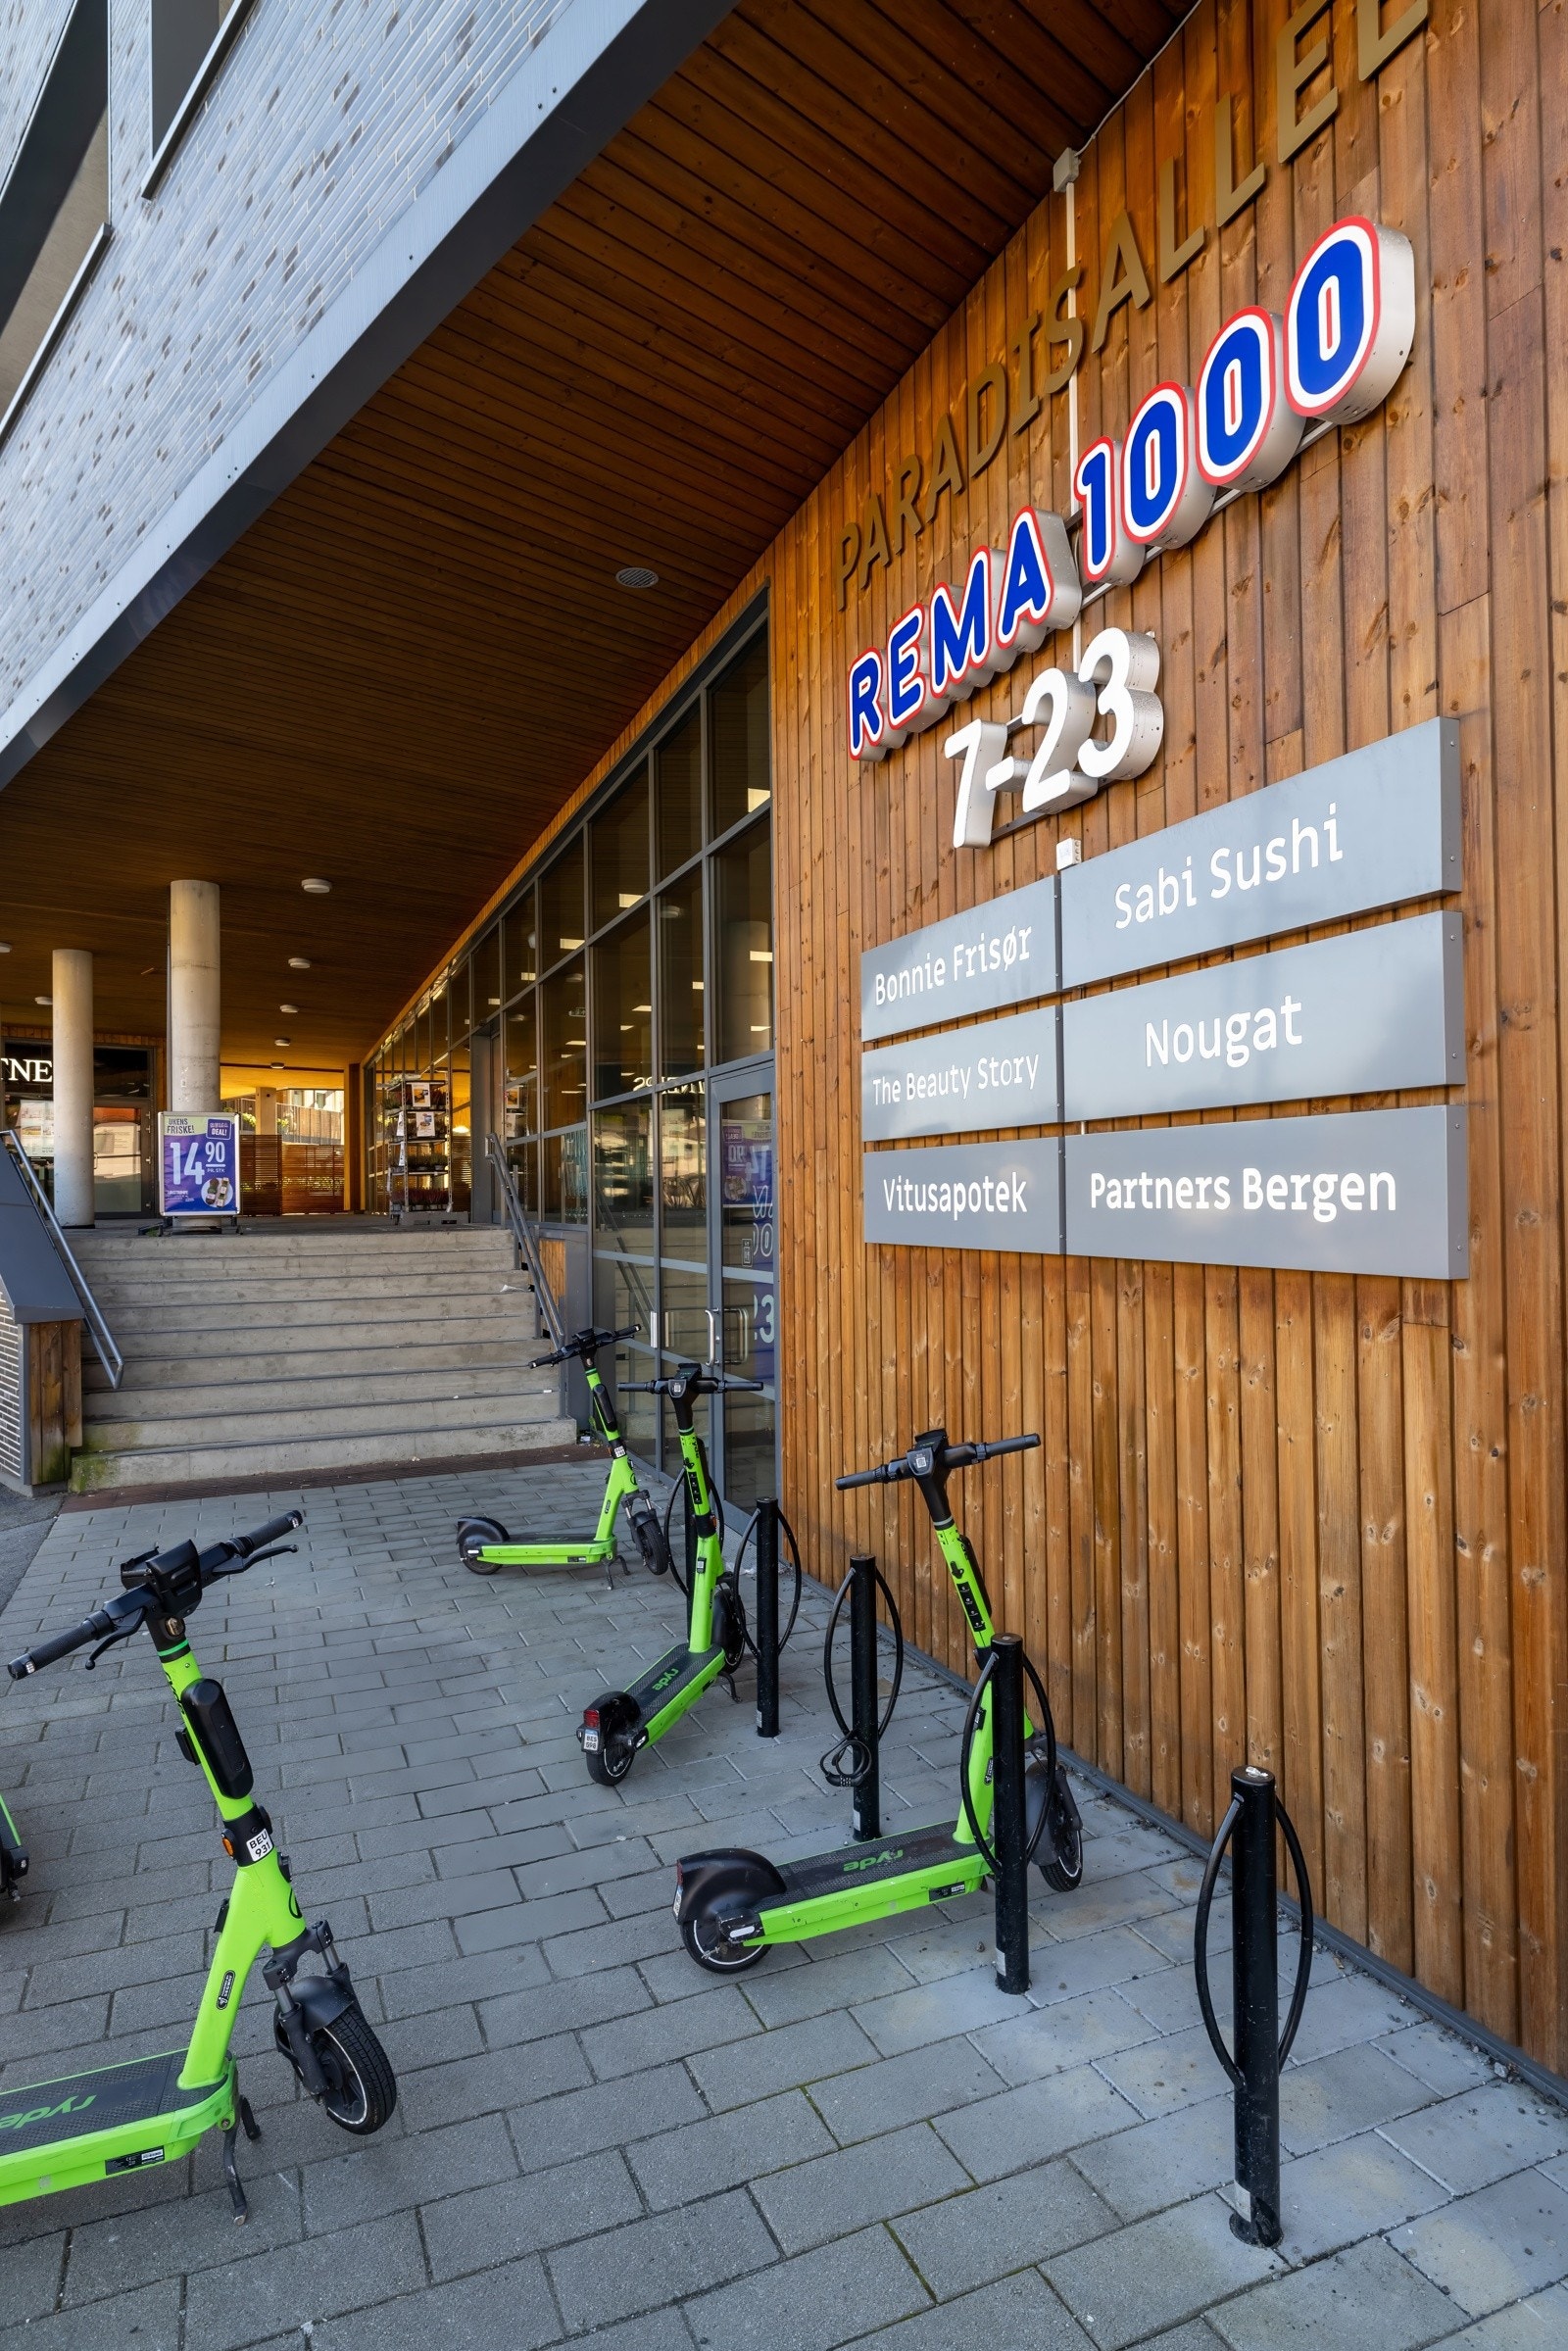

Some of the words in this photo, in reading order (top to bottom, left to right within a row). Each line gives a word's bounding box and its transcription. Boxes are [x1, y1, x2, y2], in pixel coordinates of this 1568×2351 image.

[849, 505, 1055, 761] REMA
[1074, 215, 1381, 582] 1000
[944, 626, 1137, 850] 7-23
[1113, 855, 1198, 930] Sabi
[1209, 801, 1344, 900] Sushi
[874, 952, 947, 1007] Bonnie
[953, 924, 1032, 983] Frisør
[1145, 994, 1303, 1068] Nougat
[872, 1075, 902, 1106] The
[906, 1064, 972, 1100] Beauty
[977, 1053, 1040, 1090] Story
[167, 1125, 195, 1134] FRISKE!
[170, 1142, 205, 1185] 14
[205, 1141, 225, 1163] 90
[883, 1171, 1028, 1221] Vitusapotek
[1091, 1172, 1231, 1210] Partners
[1243, 1167, 1396, 1223] Bergen
[652, 1668, 679, 1690] ryde
[249, 1831, 268, 1849] BEU
[255, 1841, 270, 1857] 931
[843, 1849, 904, 1872] ryde
[0, 2095, 97, 2129] ryde
